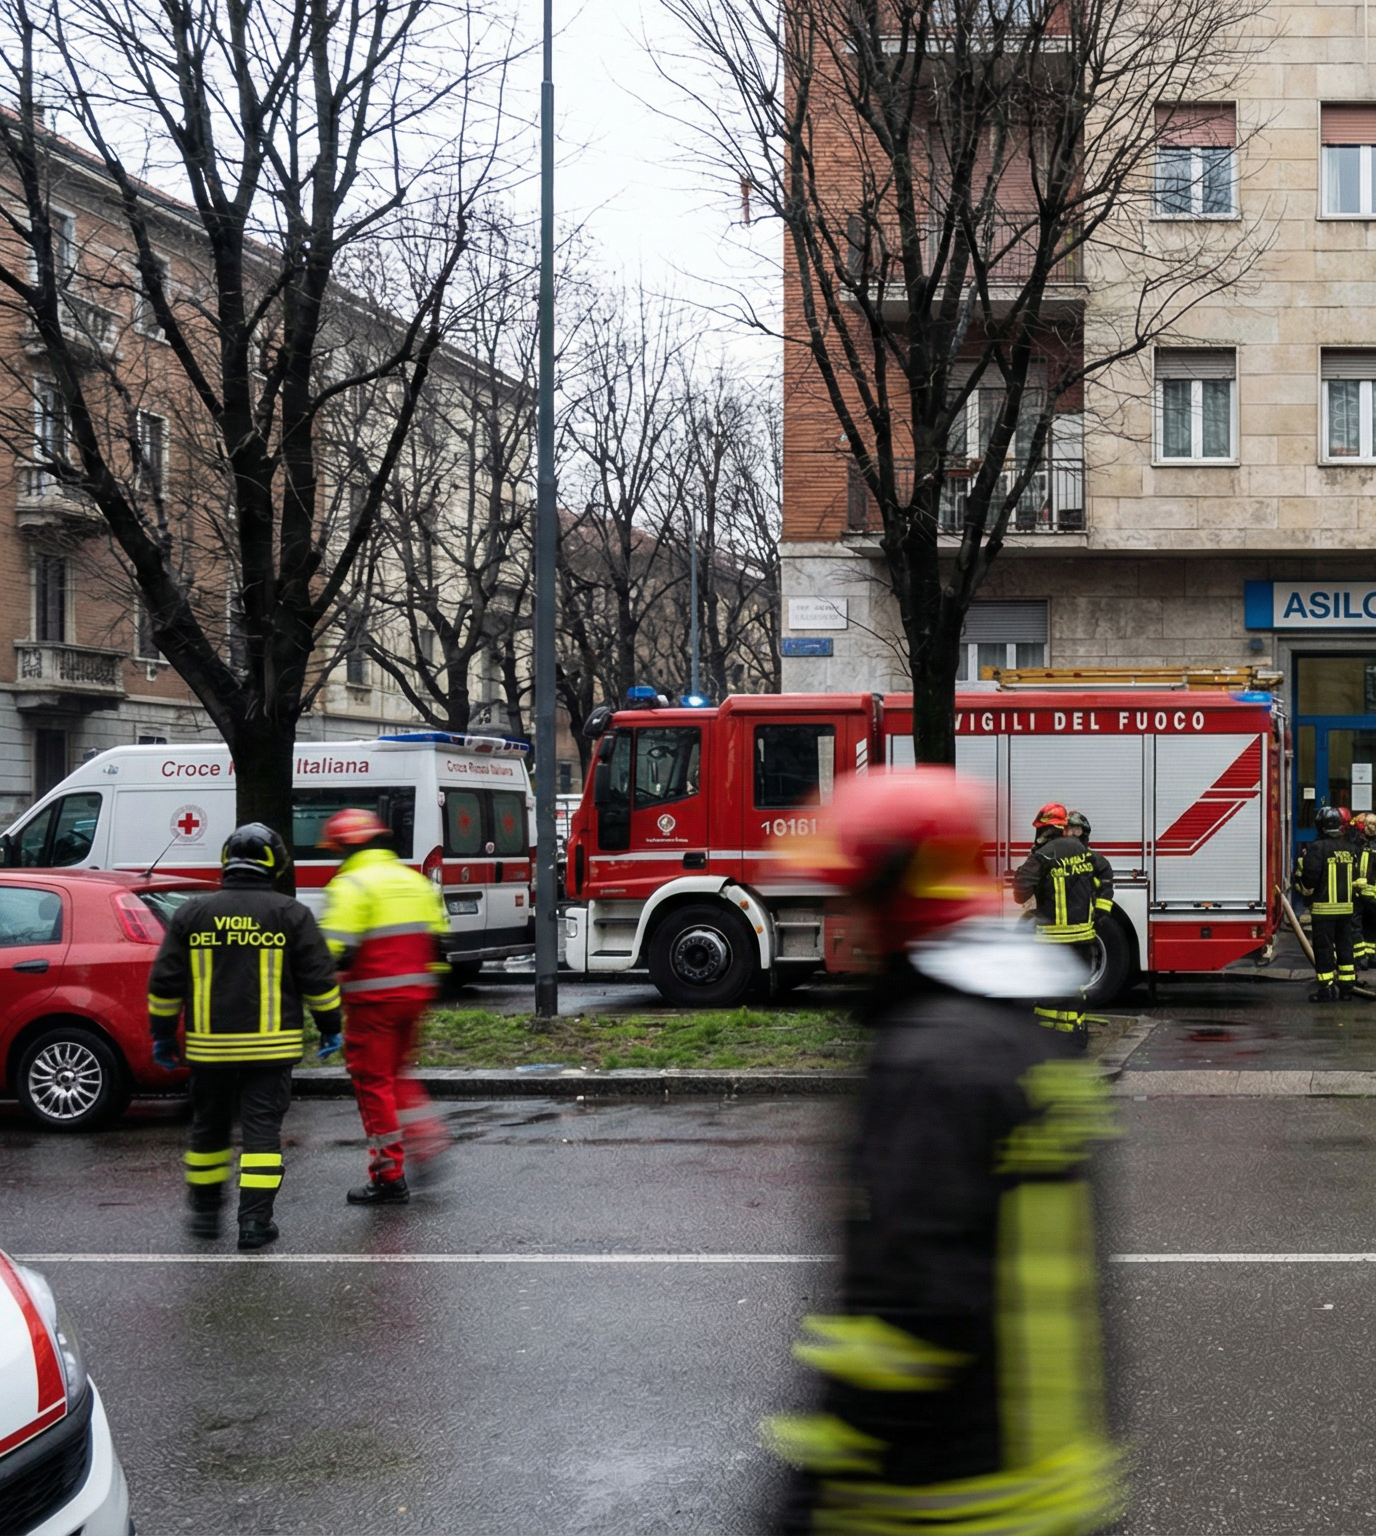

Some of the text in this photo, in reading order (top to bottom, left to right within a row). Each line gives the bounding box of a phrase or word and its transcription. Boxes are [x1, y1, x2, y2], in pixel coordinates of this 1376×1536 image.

[1054, 711, 1100, 731] DEL
[1118, 711, 1205, 730] FUOCO
[161, 760, 221, 777] Croce
[296, 757, 370, 775] Italiana
[189, 931, 287, 946] DEL FUOCO
